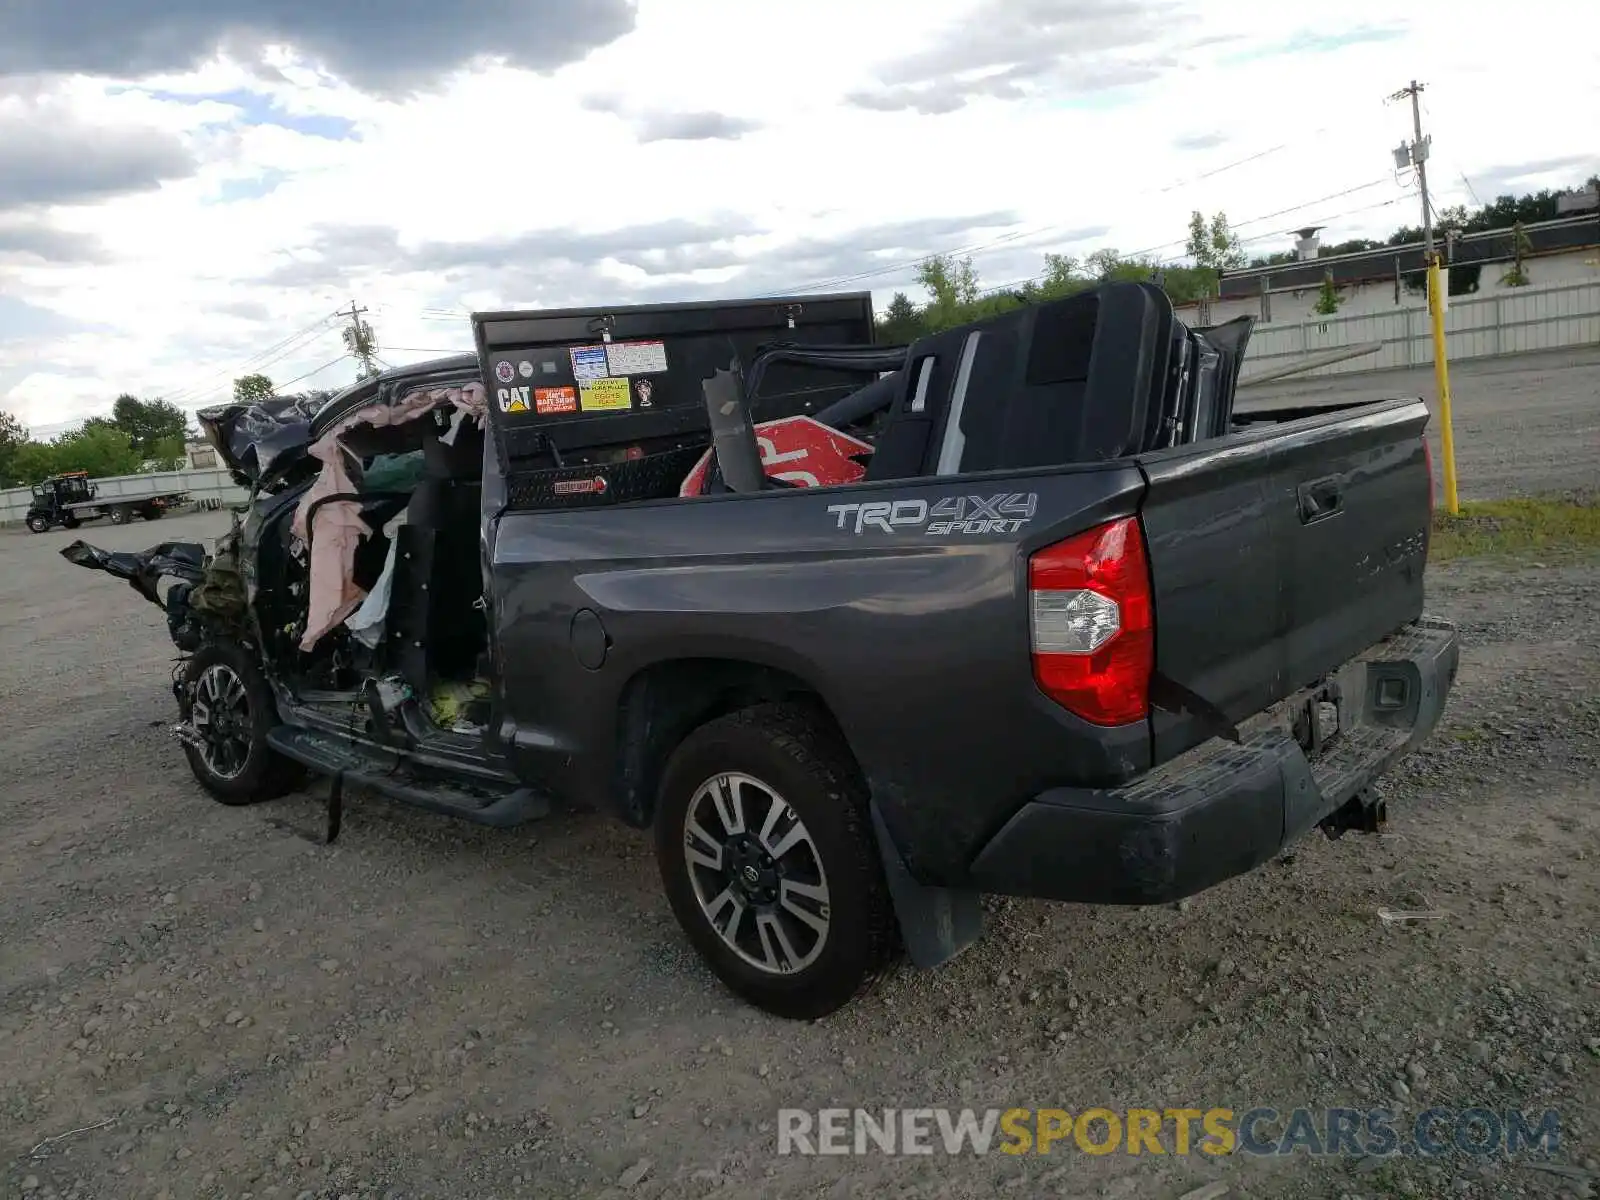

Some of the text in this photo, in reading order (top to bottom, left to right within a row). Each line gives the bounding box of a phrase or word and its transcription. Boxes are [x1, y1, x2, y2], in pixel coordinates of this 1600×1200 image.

[497, 386, 531, 412] CAT
[827, 499, 928, 534] TRD
[925, 518, 1031, 535] SPORT
